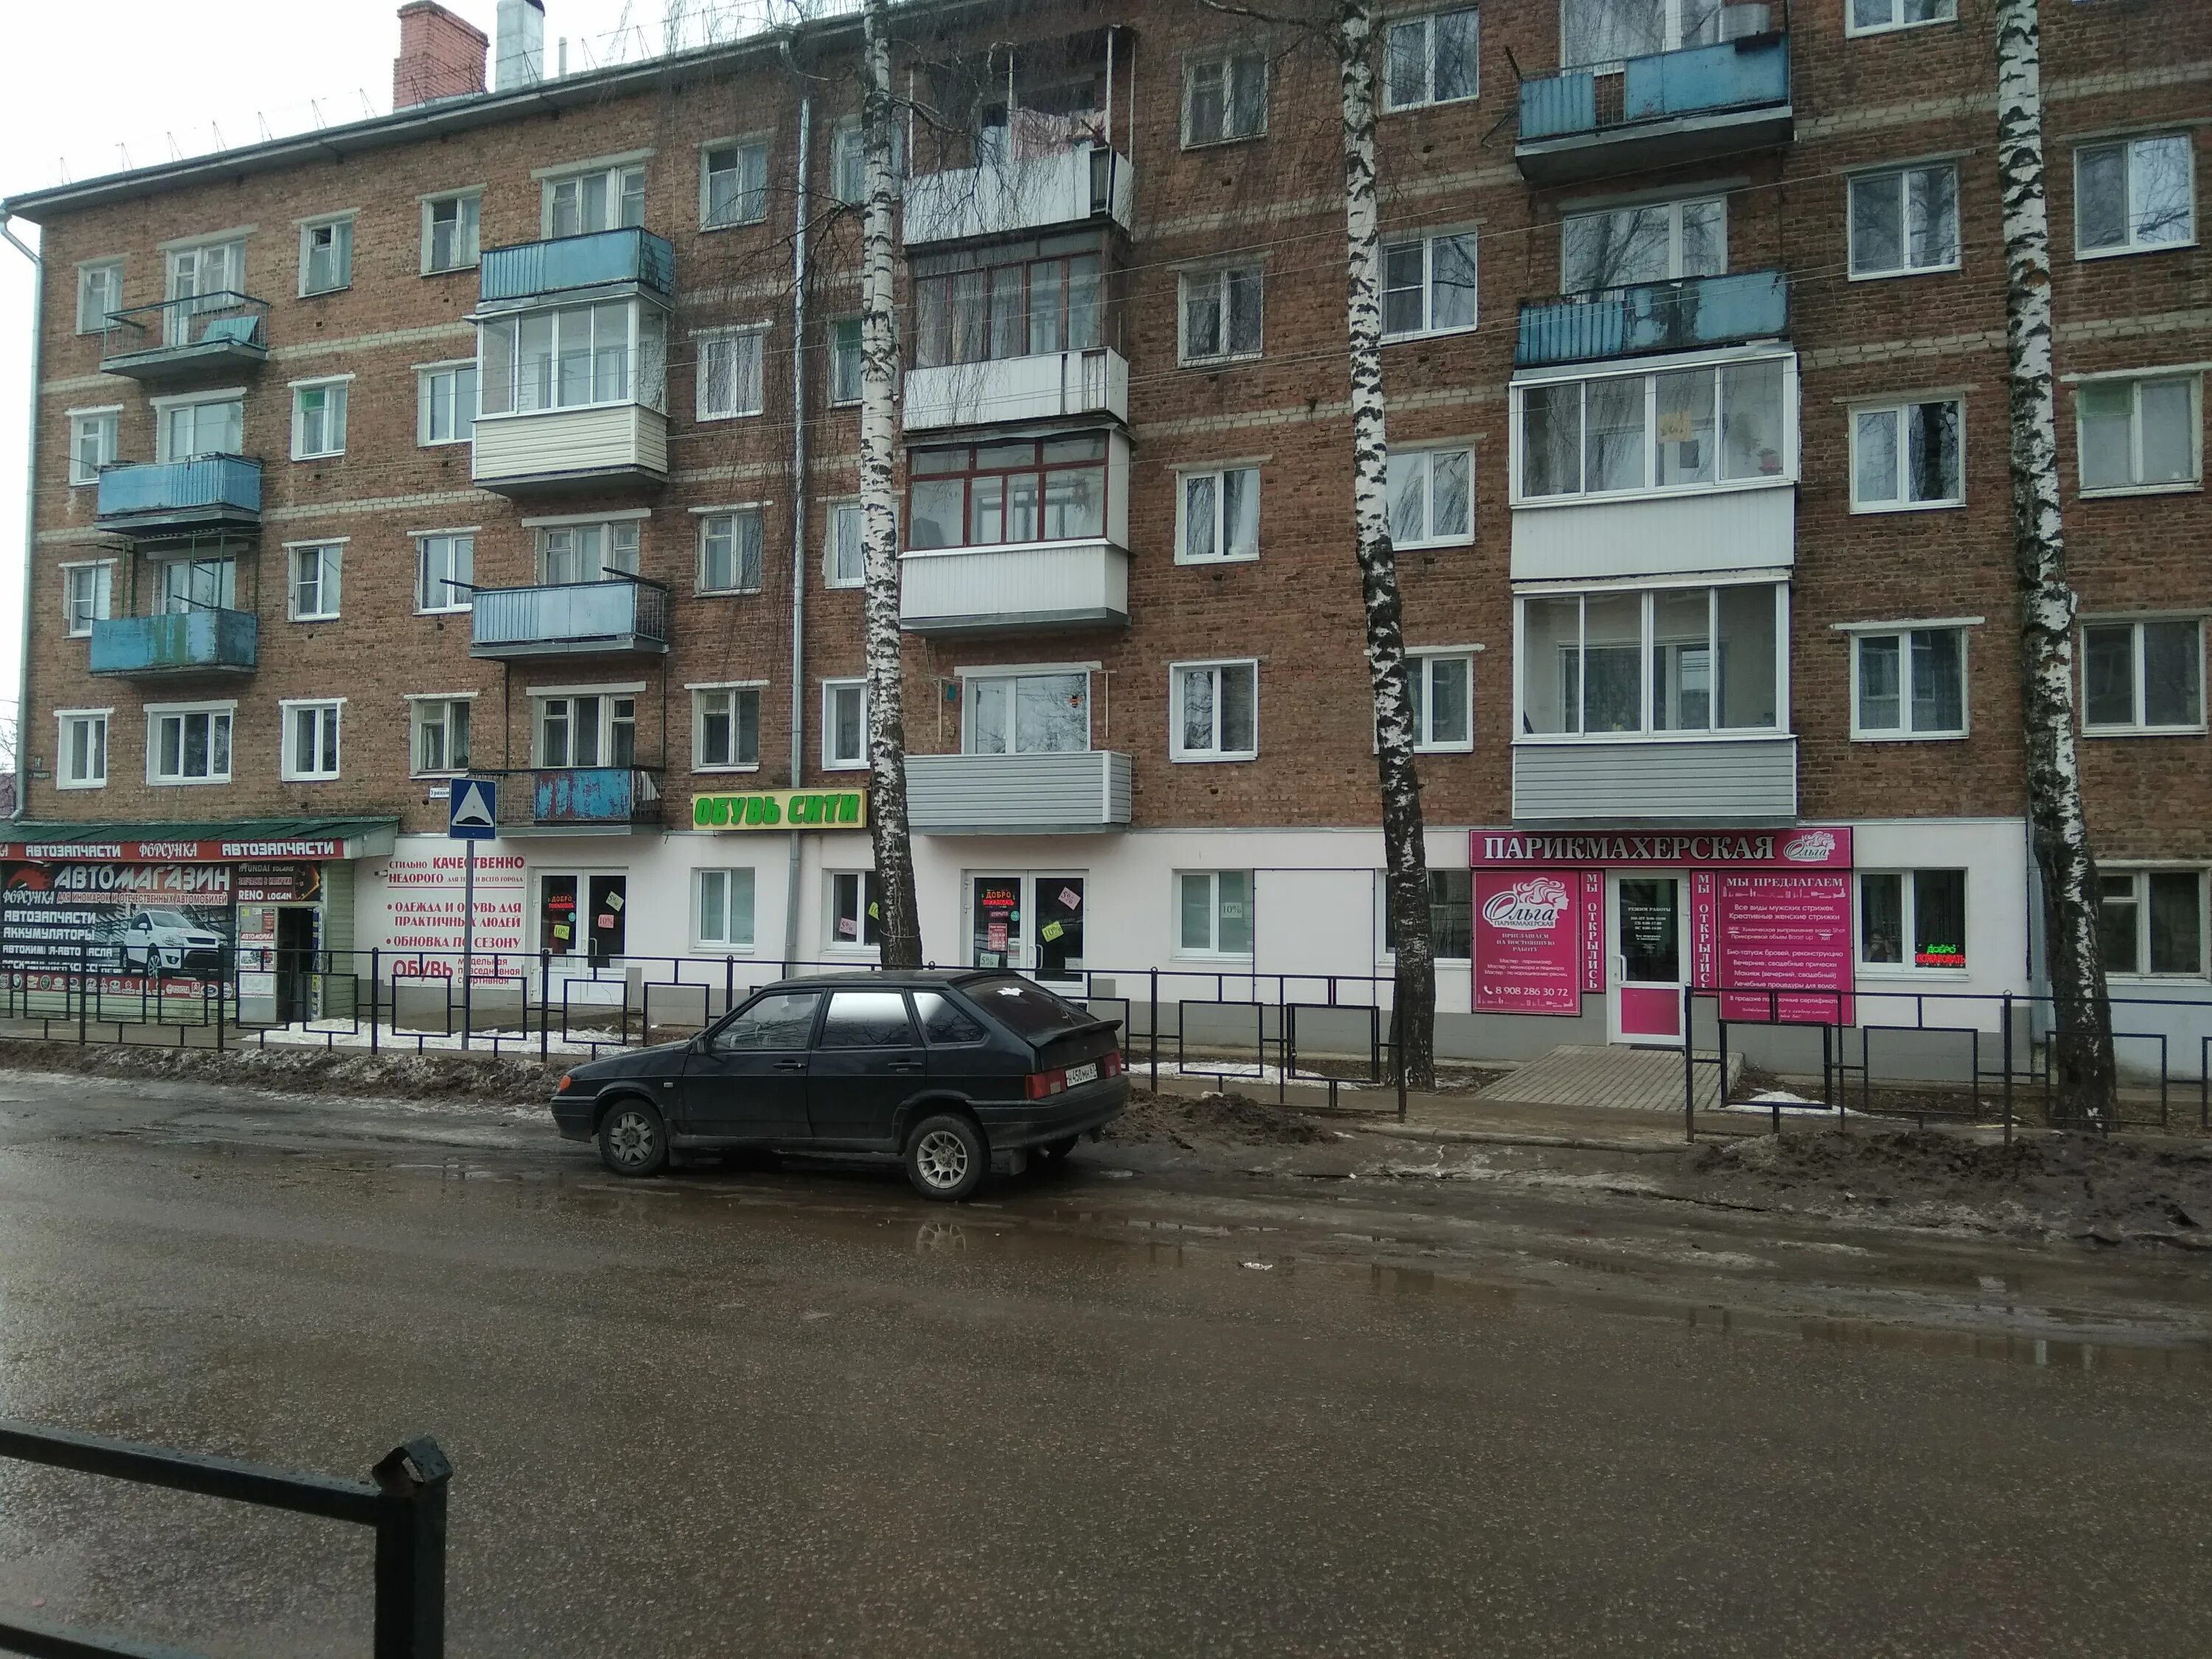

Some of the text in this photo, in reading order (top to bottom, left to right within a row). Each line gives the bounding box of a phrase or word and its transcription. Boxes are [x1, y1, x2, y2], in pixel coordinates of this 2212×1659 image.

[695, 794, 860, 825] ОБУВЬ СИТИ
[26, 845, 121, 858] АВТОЗАПЧАСТИ
[222, 841, 334, 856] АВТОЗАПЧАСТИ
[1484, 837, 1775, 860] ПАРИКМАХЕРСКАЯ
[238, 863, 270, 872] HYUNDAI
[54, 865, 230, 891] АВТОМАГАЗИН
[389, 874, 443, 883] НЕДОРОГО
[1698, 874, 1710, 894] МЫ
[1727, 877, 1843, 887] МЫ ПРЕДЛАГАЕМ
[57, 891, 71, 904] ДЛЯ
[72, 891, 111, 904] ИНОМАРОК
[119, 893, 175, 905] ОТЕЧЕСТВЕННЫХ
[175, 891, 228, 905] АВТОМОБИЛЕЙ
[238, 890, 292, 900] RENO LOGAN
[1060, 891, 1074, 904] 5%
[395, 902, 521, 913] ОДЕЖДА И ОУВЬ ДЛЯ
[1223, 905, 1242, 914] 10%
[1485, 892, 1554, 921] Ольга
[4, 910, 97, 924] АВТОЗАПЧАСТИ
[479, 915, 521, 928] ЛЮДЕЙ
[599, 917, 613, 925] 10%
[3, 927, 95, 940] АККУМУЛЯТОРЫ
[555, 928, 568, 936] 10%
[1044, 925, 1062, 937] 10%
[1587, 874, 1599, 989] МЫ ОТКРЫЛИСЬ
[394, 936, 449, 947] ОБНОВКА
[474, 937, 521, 949] СЕЗОНУ
[2, 945, 113, 957] АВТОХИМЯ-АВТОАСЛА
[1927, 945, 1957, 954] ДОБРО
[458, 958, 507, 967] мдельая
[981, 956, 994, 966] 5%
[392, 960, 453, 981] ОБУВЬ
[458, 967, 520, 975] пвседнвная
[457, 977, 509, 986] сортивная
[1495, 987, 1568, 996] 8 908 286 30 72
